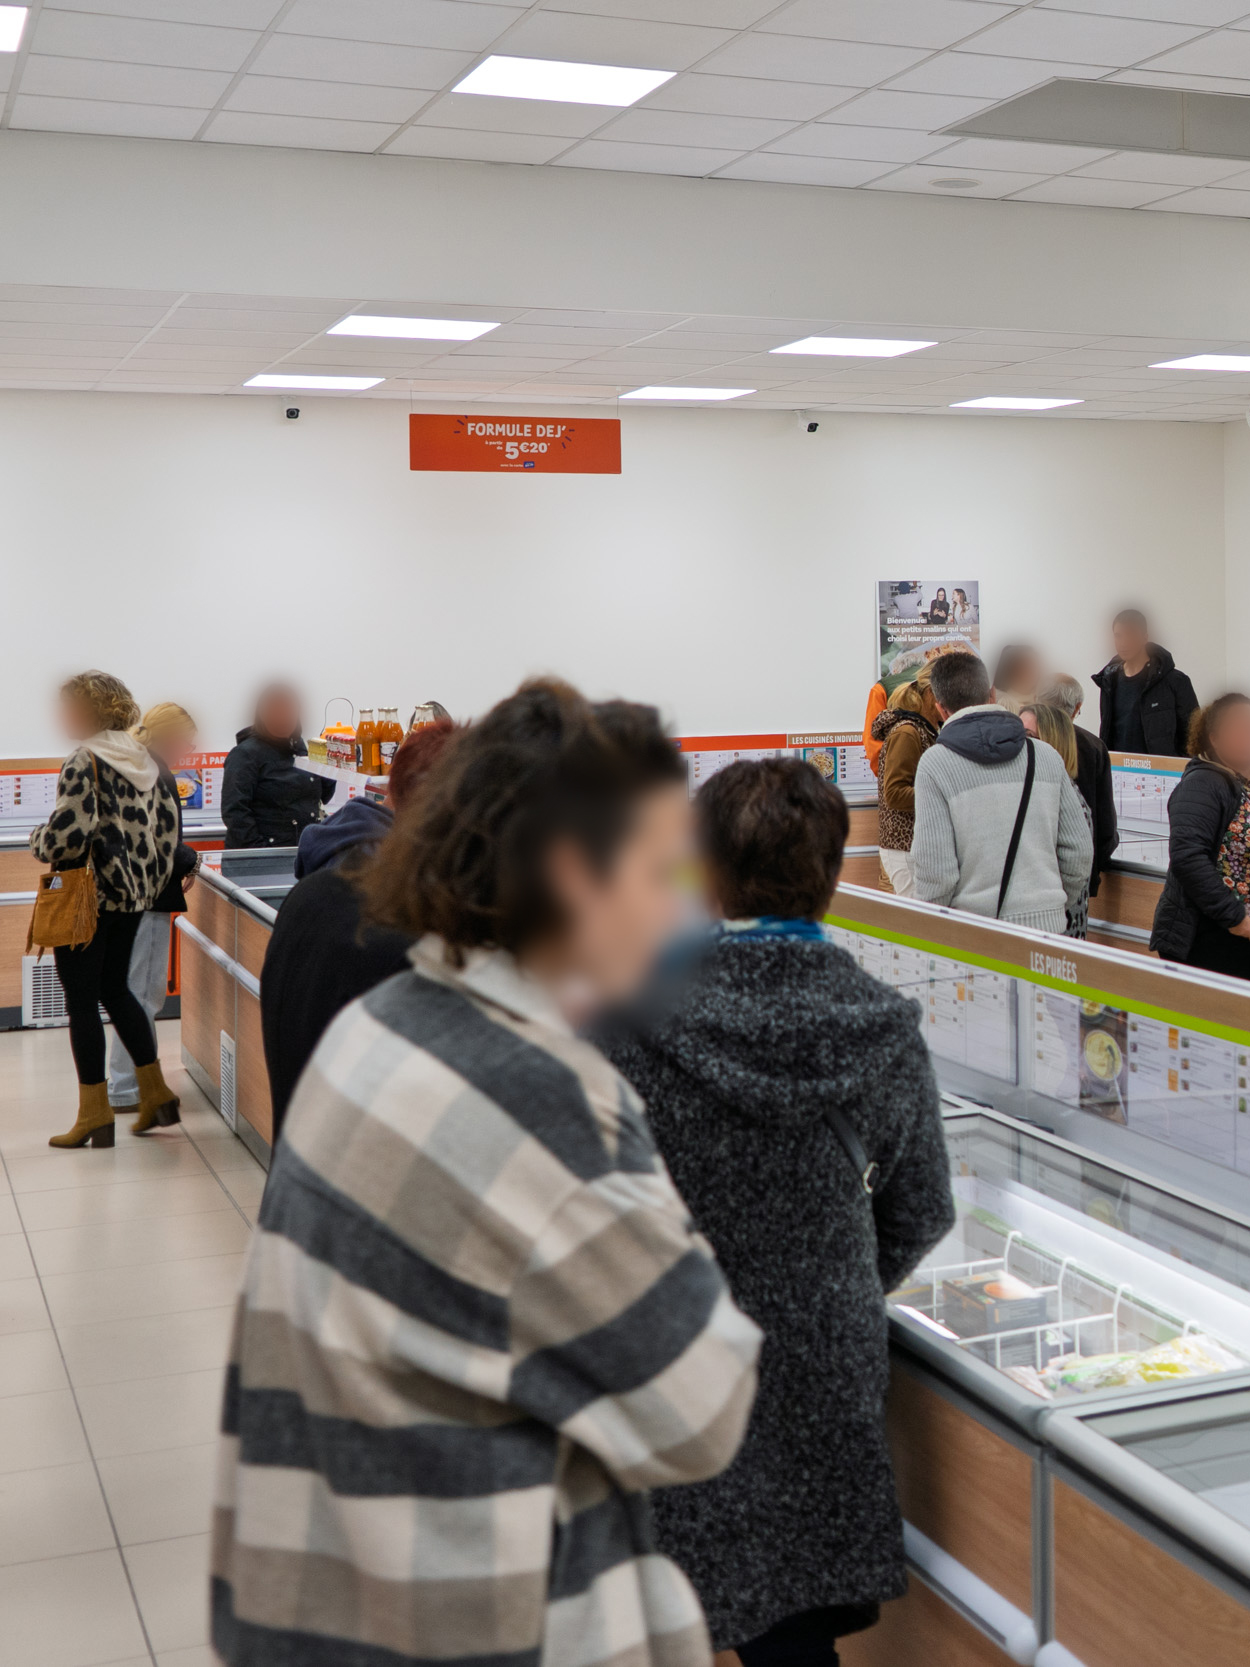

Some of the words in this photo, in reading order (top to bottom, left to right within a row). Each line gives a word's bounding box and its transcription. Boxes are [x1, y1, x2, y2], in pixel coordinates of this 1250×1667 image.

[467, 422, 532, 437] FORMULE
[901, 626, 922, 634] petits
[923, 625, 946, 633] malins
[947, 626, 958, 634] qui
[922, 635, 945, 643] propre
[792, 736, 804, 745] LES
[804, 734, 834, 744] CUISINÉS
[834, 734, 863, 743] INDIVIDU
[201, 754, 207, 765] À
[209, 756, 227, 765] PAR
[1030, 950, 1045, 975] LES
[1046, 955, 1078, 984] PURÉES
